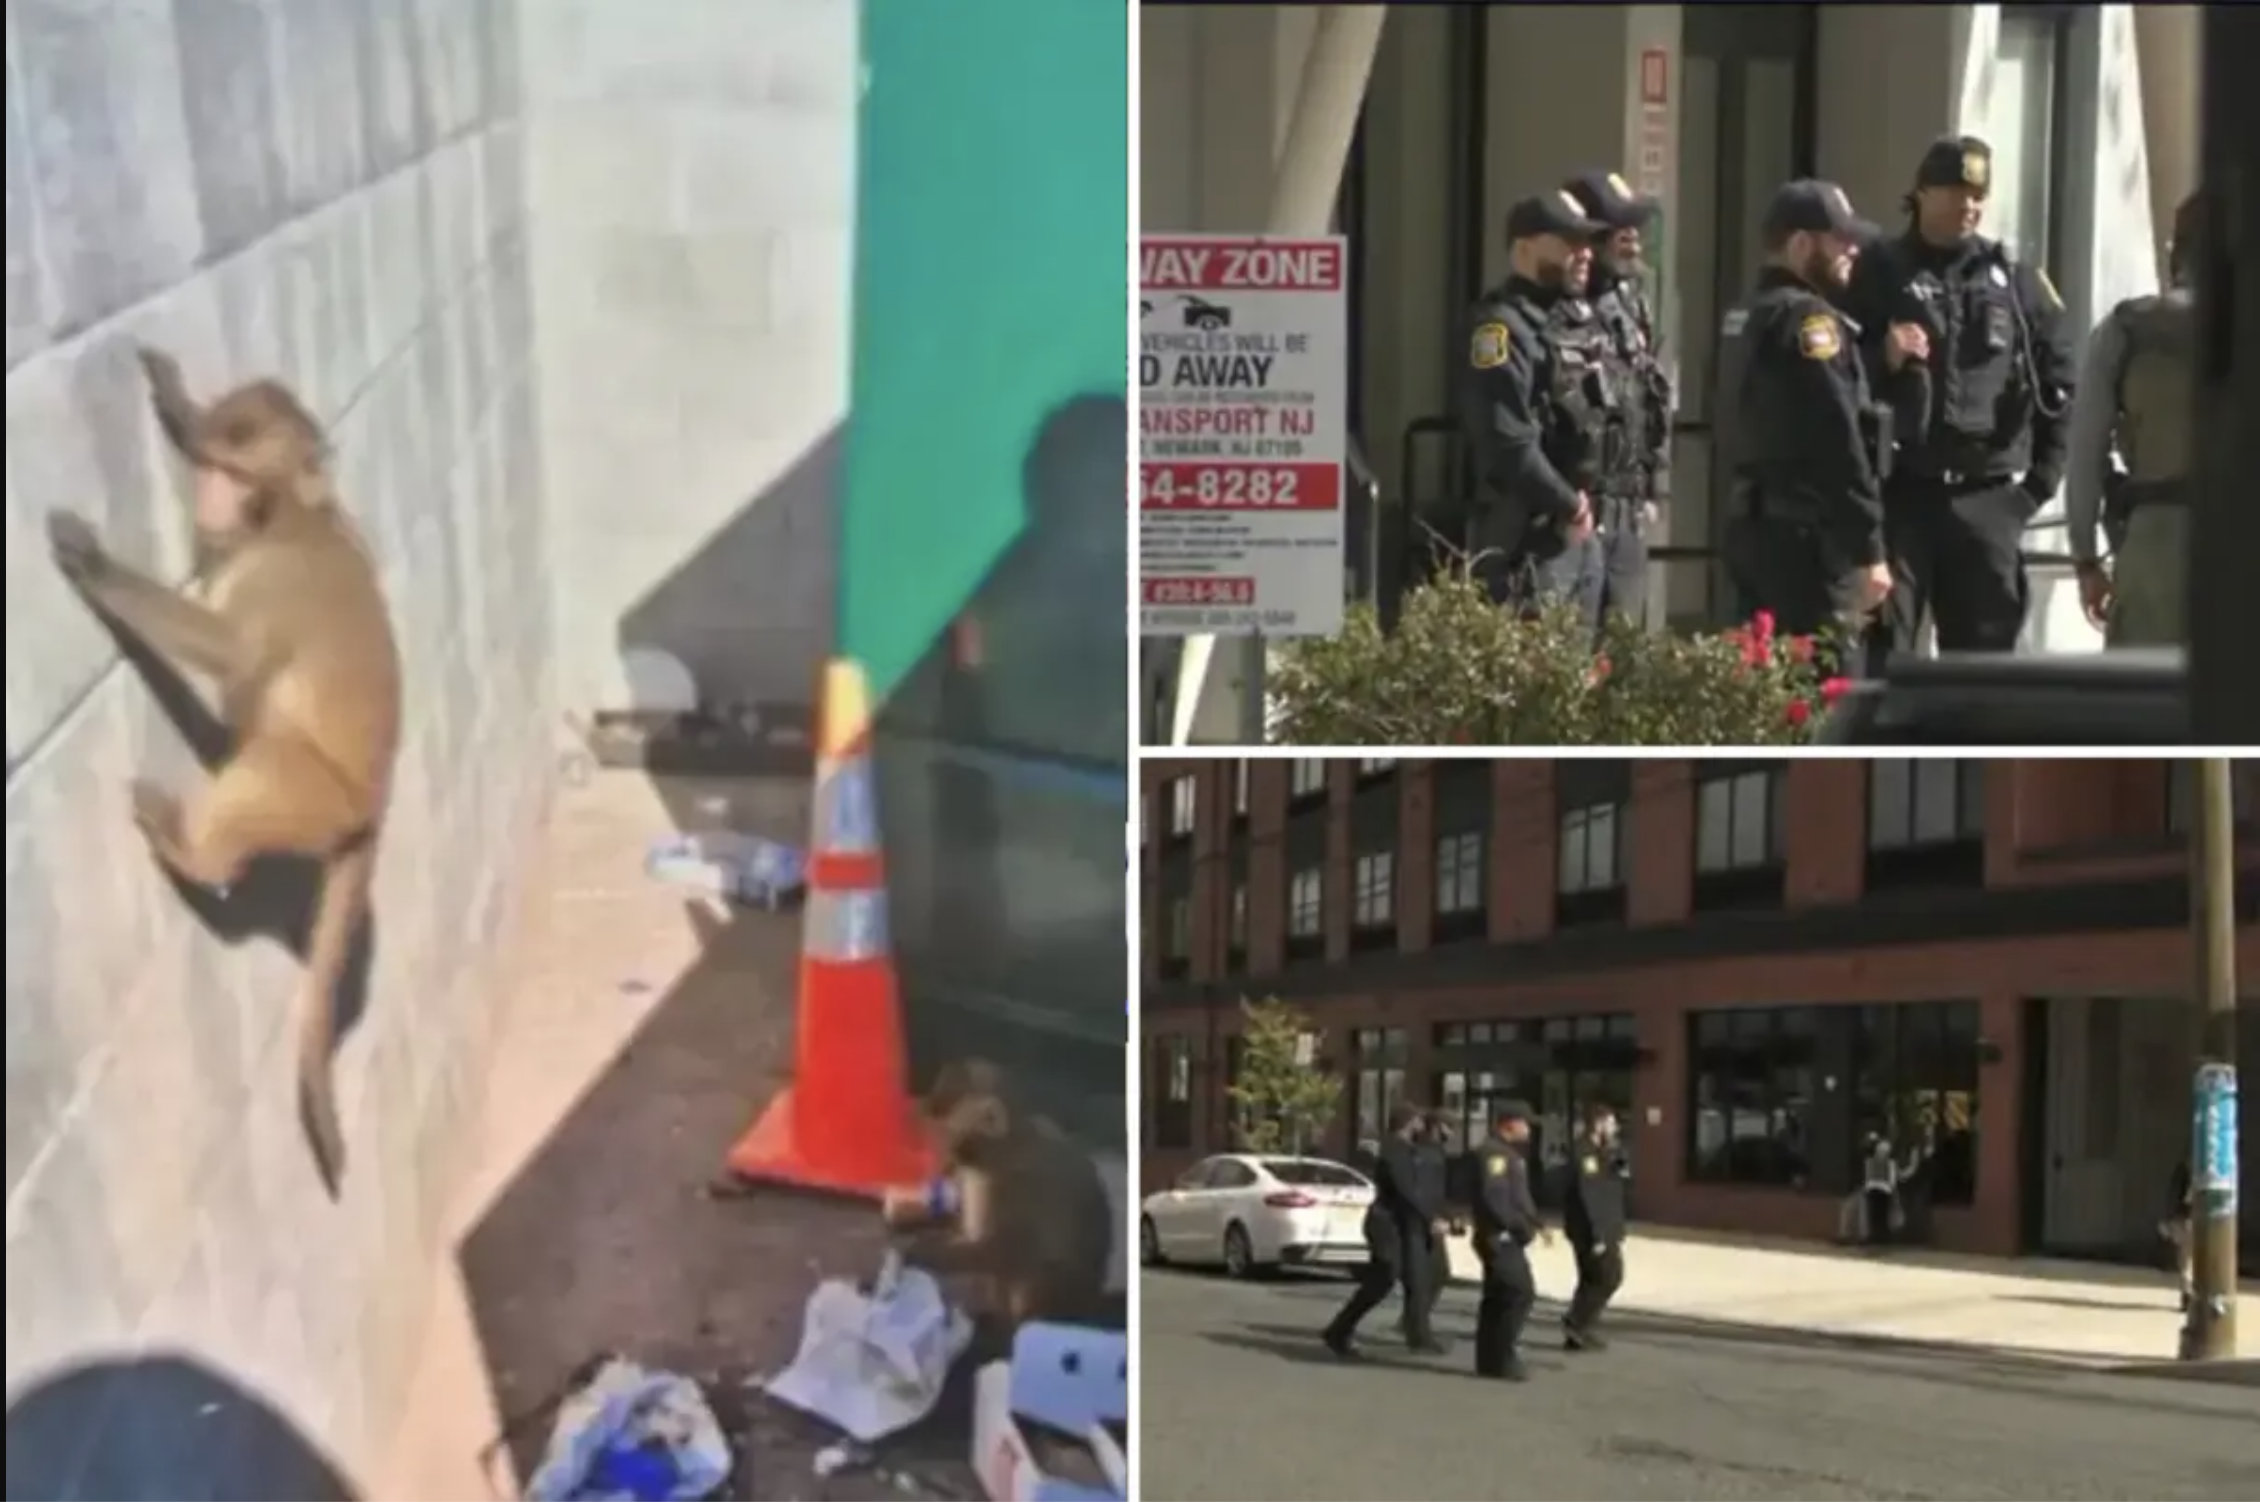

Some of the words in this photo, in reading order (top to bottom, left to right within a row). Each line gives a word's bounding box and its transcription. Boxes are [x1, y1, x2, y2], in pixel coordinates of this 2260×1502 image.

[1220, 248, 1334, 286] ZONE
[1285, 334, 1308, 353] BE
[1172, 355, 1273, 388] AWAY
[1280, 409, 1315, 435] NJ
